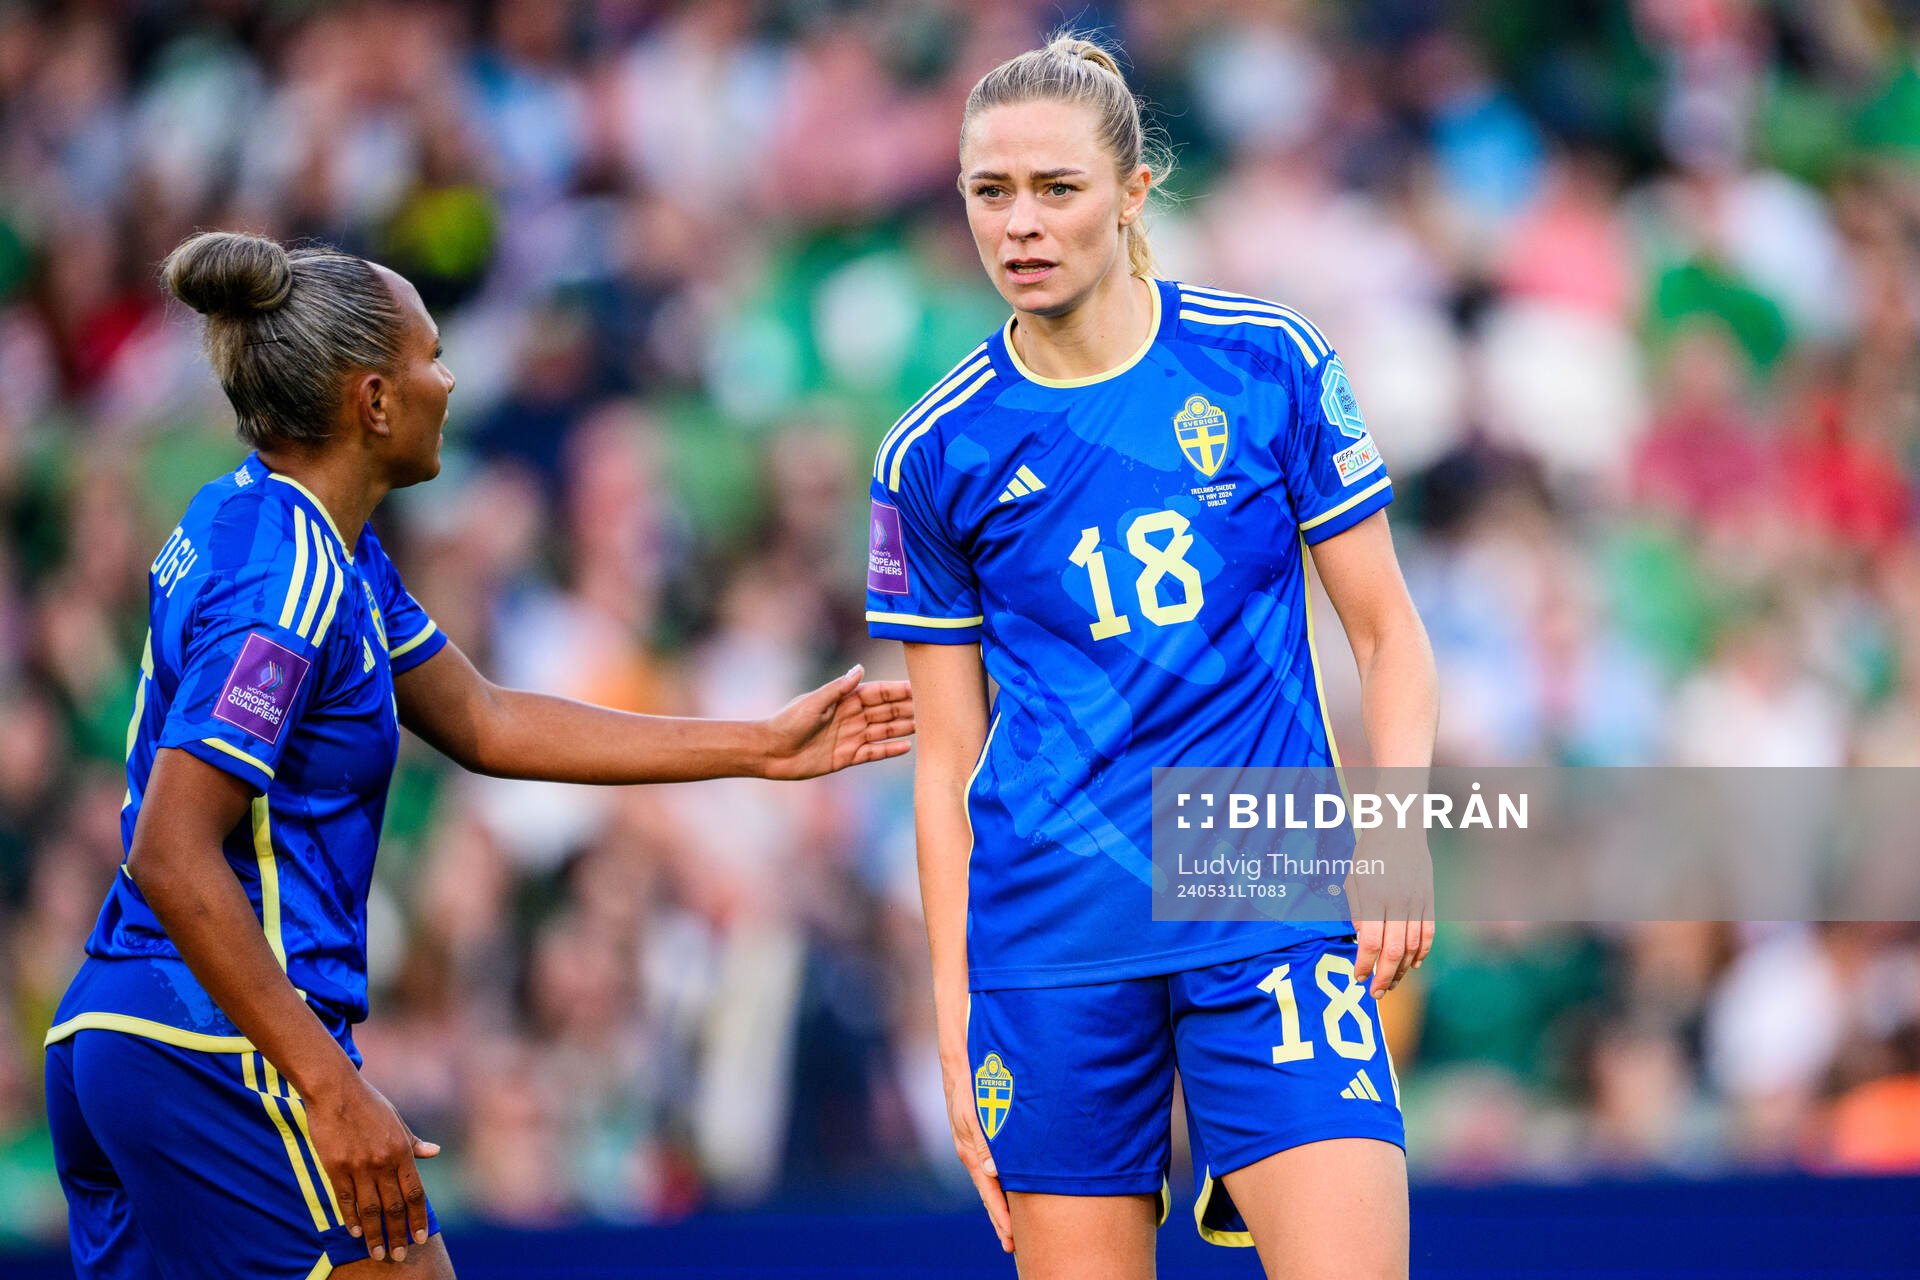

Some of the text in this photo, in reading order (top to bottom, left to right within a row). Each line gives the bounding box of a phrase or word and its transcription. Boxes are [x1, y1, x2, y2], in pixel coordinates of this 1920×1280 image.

[1182, 417, 1219, 428] SVERIGE
[1336, 449, 1354, 464] UEFA
[1339, 446, 1376, 476] FOUND
[1198, 494, 1206, 502] 31
[1218, 491, 1233, 499] 2024
[1207, 499, 1227, 508] DUBLIN
[150, 526, 198, 598] OGY
[871, 549, 891, 558] omen's
[1068, 510, 1205, 641] 18
[231, 686, 283, 717] EUROPEAN
[246, 684, 277, 704] women's
[227, 694, 280, 726] QUALIFIERS
[1256, 953, 1377, 1065] 18
[980, 1079, 1007, 1088] SVERIGE
